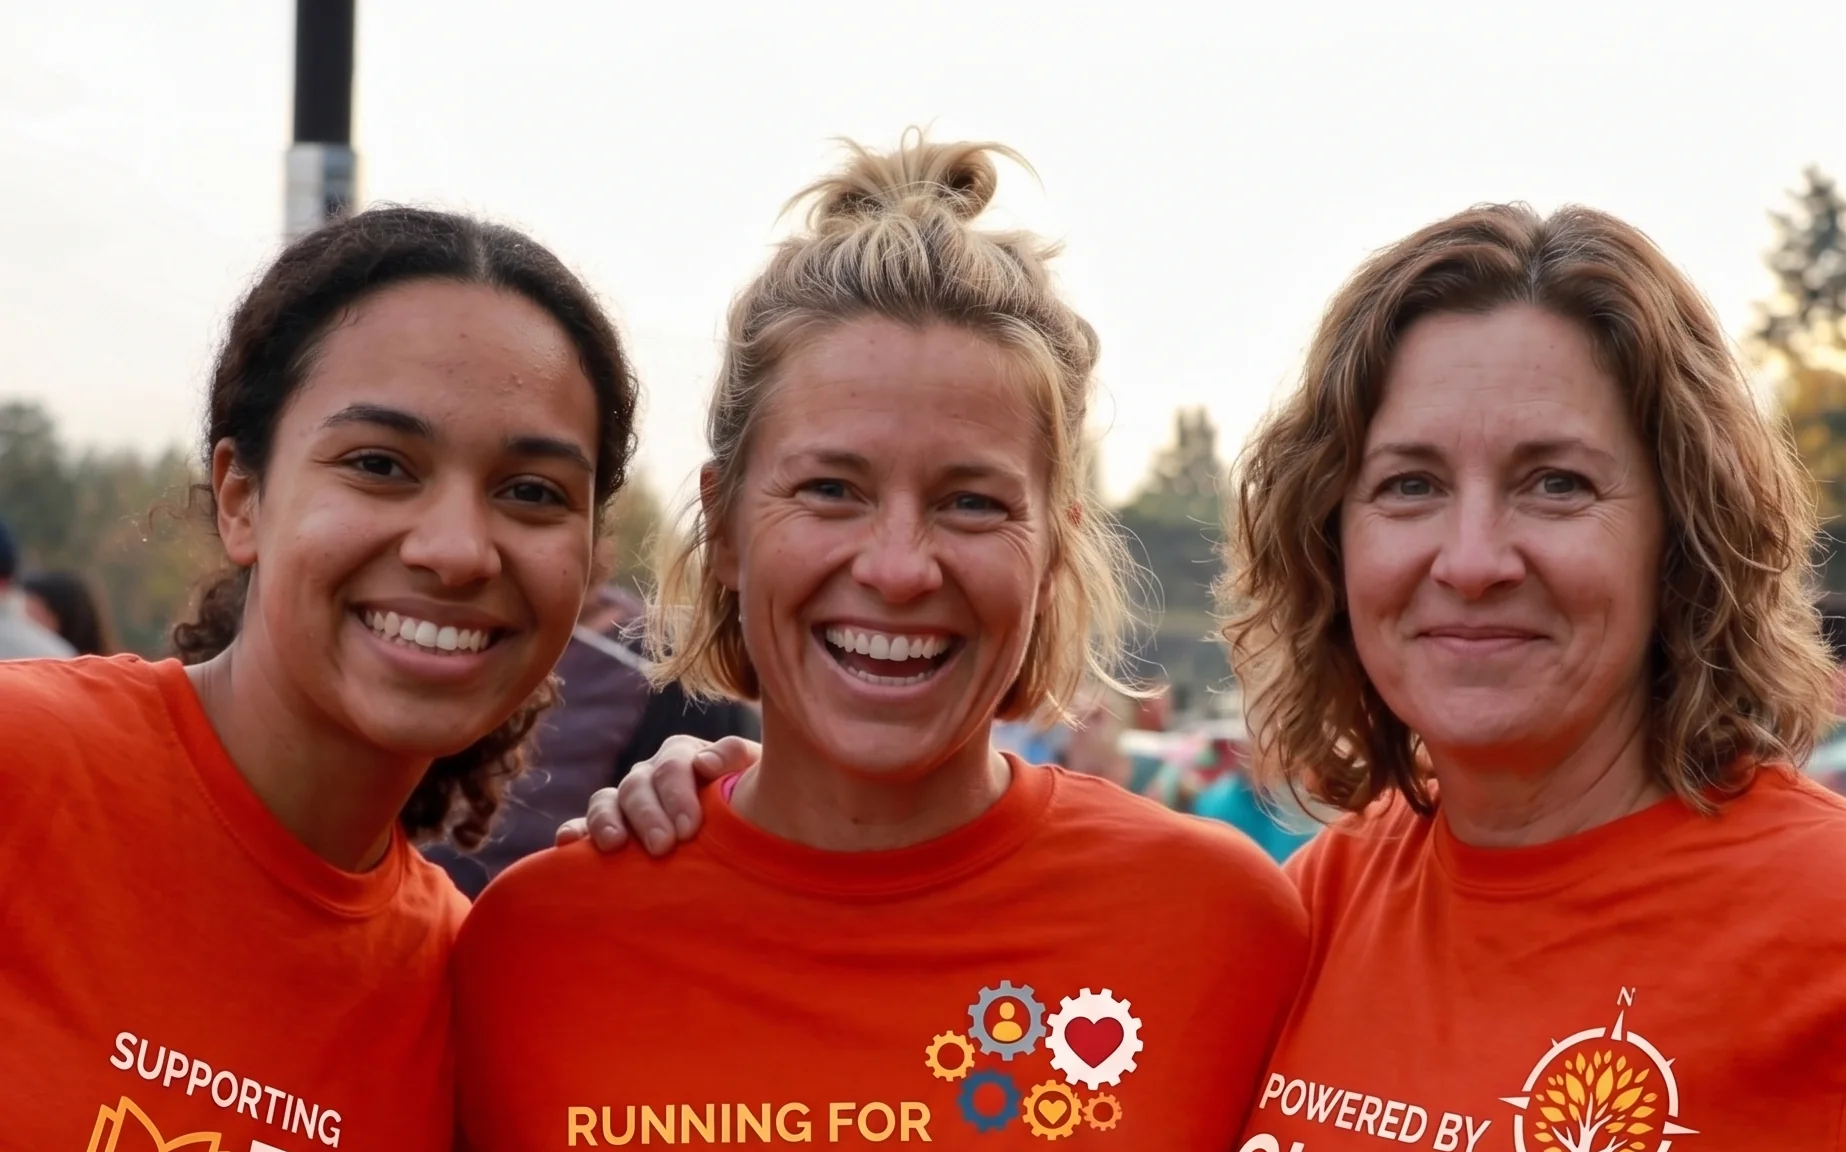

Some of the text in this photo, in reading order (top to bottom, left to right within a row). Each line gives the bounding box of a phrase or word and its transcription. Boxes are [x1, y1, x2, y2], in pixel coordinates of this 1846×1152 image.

[1616, 985, 1637, 1007] N
[109, 1031, 342, 1148] SUPPORTING
[1258, 1072, 1429, 1144] POWERED
[567, 1100, 932, 1146] RUNNING FOR
